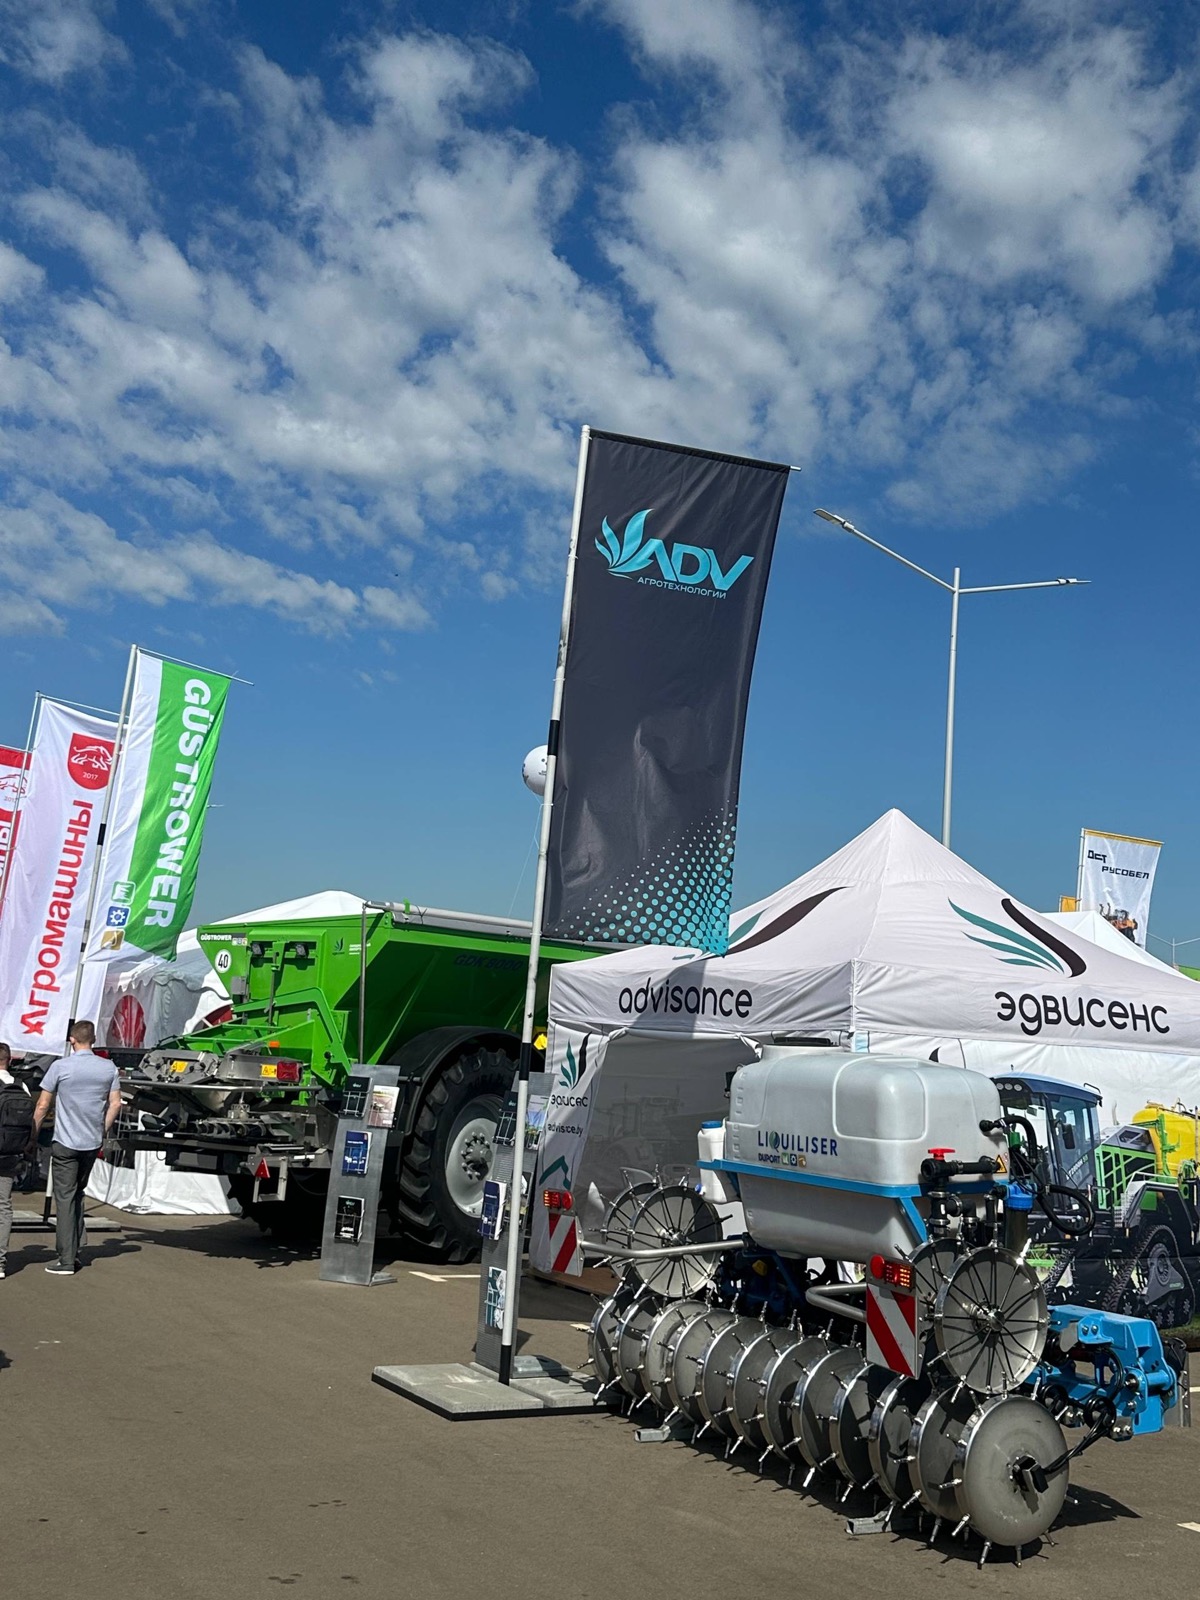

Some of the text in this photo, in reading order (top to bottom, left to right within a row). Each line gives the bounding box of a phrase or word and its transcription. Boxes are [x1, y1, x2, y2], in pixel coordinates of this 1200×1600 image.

[628, 538, 754, 591] ADV
[637, 576, 727, 599] АГРОТЕХНОЛОГИИ
[82, 771, 98, 780] 2017
[143, 678, 212, 928] GÜSTROWER
[1101, 865, 1150, 880] РУСОБЕЛ
[20, 799, 94, 1037] Агромашины
[200, 933, 232, 941] GÜSTROWER
[217, 950, 229, 969] 40
[618, 976, 753, 1018] advisance
[994, 991, 1170, 1036] эдвисенс
[757, 1130, 838, 1157] LIQUILISER
[758, 1153, 781, 1164] DUPORT
